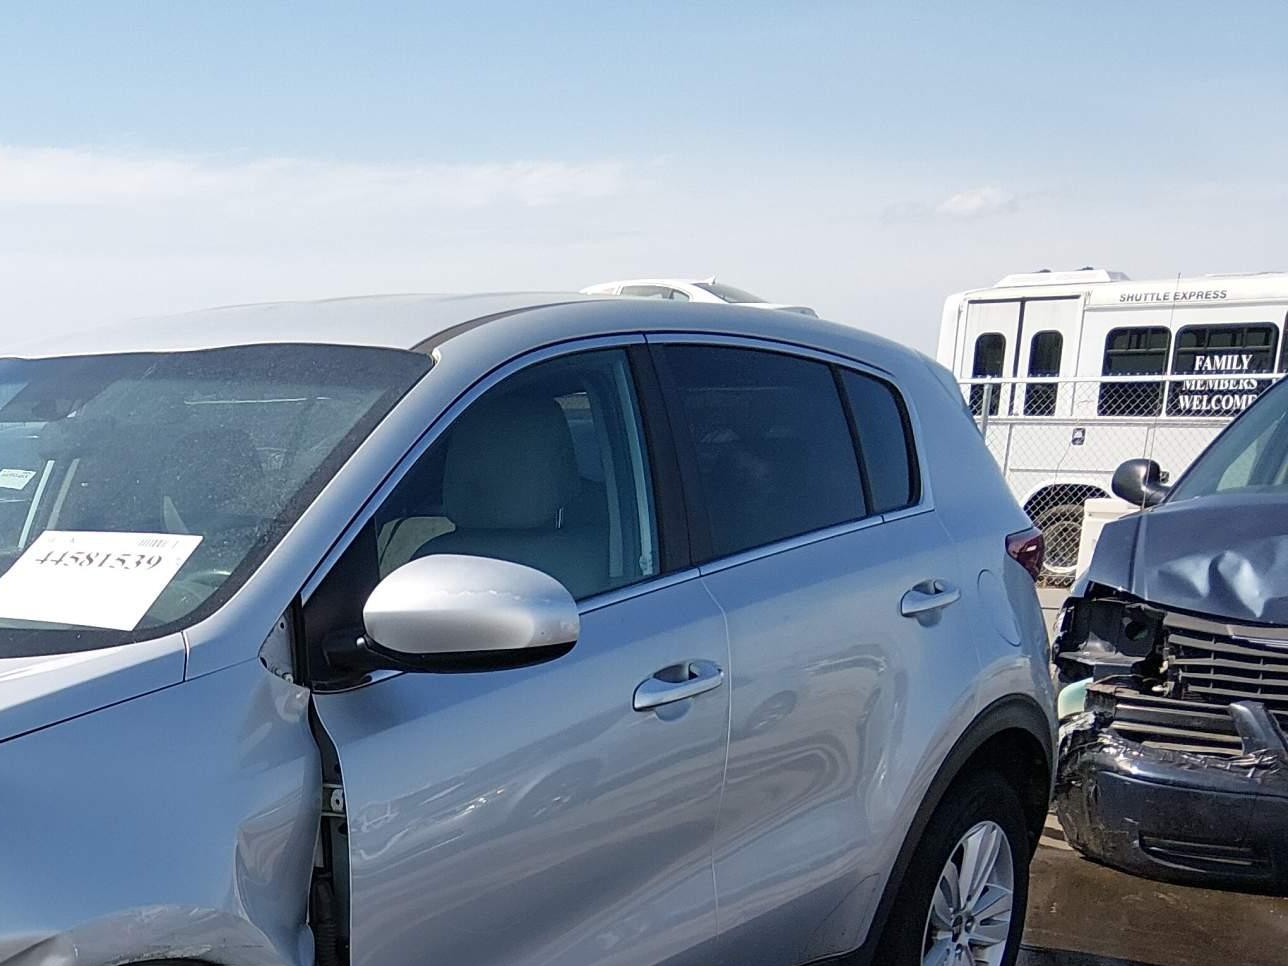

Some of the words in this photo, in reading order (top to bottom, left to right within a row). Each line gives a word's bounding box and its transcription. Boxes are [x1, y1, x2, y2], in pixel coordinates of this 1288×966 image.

[1119, 290, 1170, 302] SHUTTLE
[1173, 289, 1227, 301] EXPRESS
[1194, 354, 1253, 371] FAMILY
[1182, 378, 1258, 391] MEMBERS
[35, 551, 163, 570] 44581539
